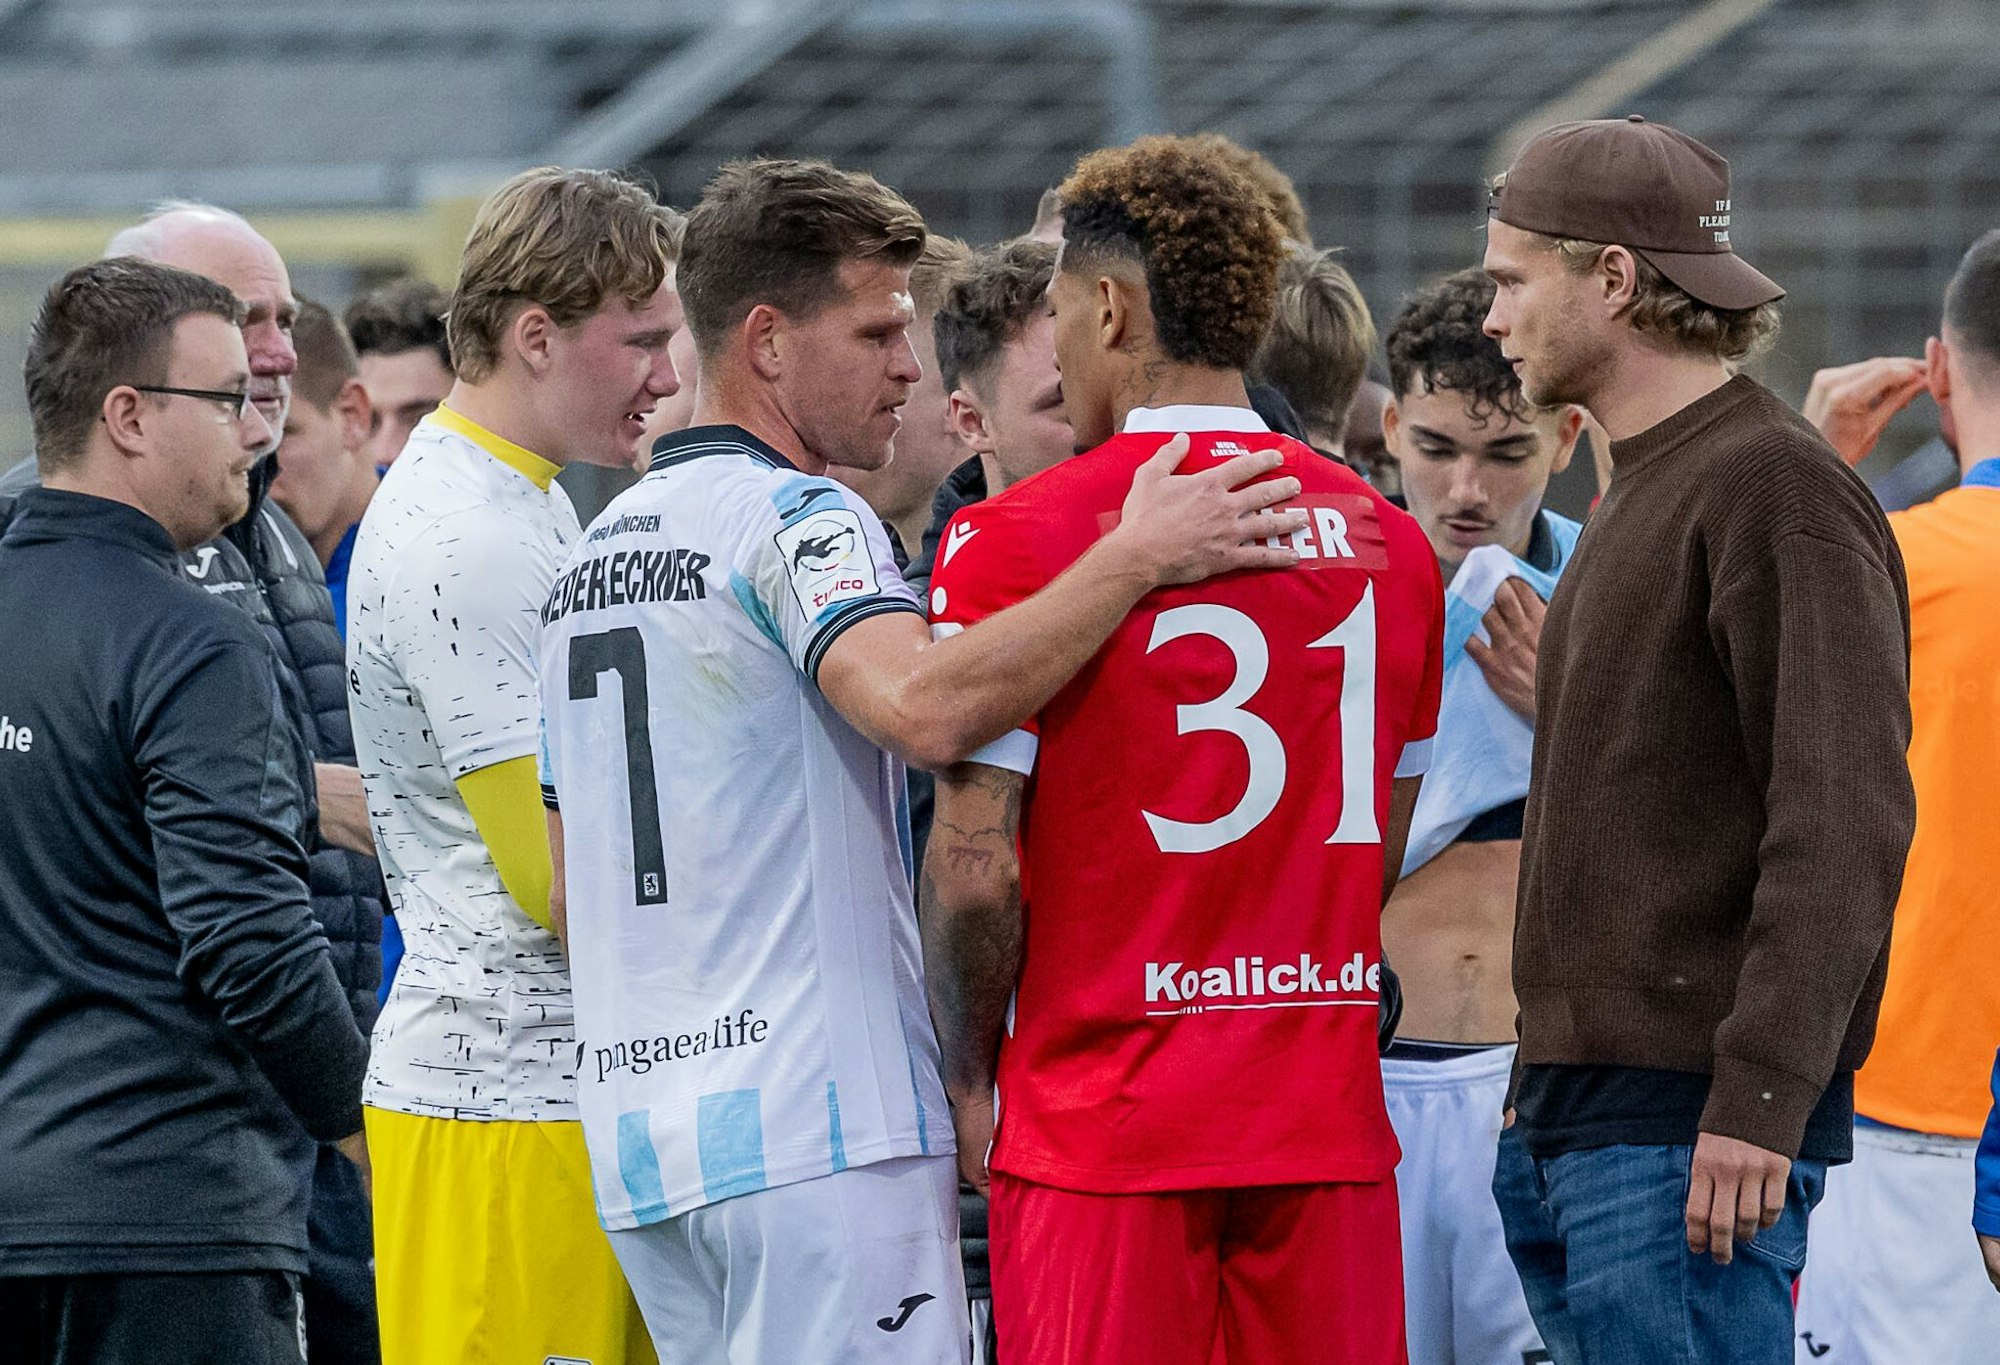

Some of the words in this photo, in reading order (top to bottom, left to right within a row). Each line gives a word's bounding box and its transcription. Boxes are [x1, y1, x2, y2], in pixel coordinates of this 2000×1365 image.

[569, 626, 668, 906] 7
[1141, 577, 1381, 853] 31
[1145, 953, 1379, 1001] Koalick.de
